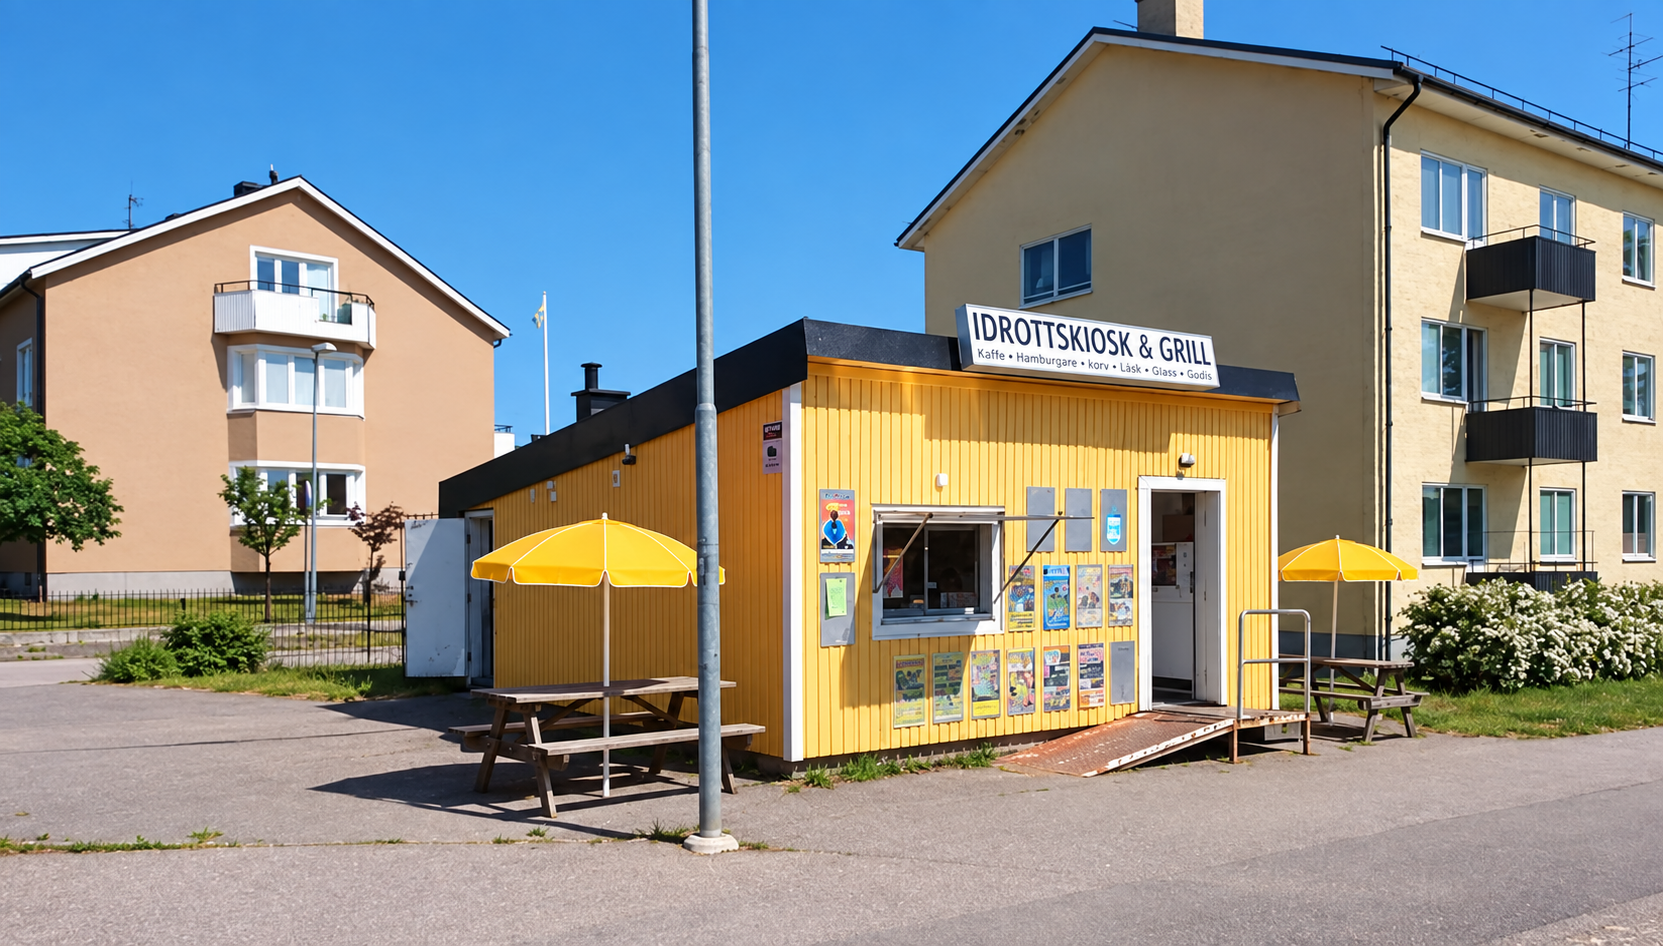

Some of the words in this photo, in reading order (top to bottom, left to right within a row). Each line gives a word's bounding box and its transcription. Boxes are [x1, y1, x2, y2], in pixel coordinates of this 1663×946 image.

[972, 312, 1134, 358] IDROTTSKIOSK
[1139, 334, 1154, 360] &
[1159, 336, 1212, 366] GRILL
[977, 347, 1005, 361] Kaffe
[1015, 352, 1078, 369] Hamburgare
[1087, 359, 1109, 371] korv
[1151, 366, 1178, 378] Glass
[1187, 369, 1213, 381] Godis
